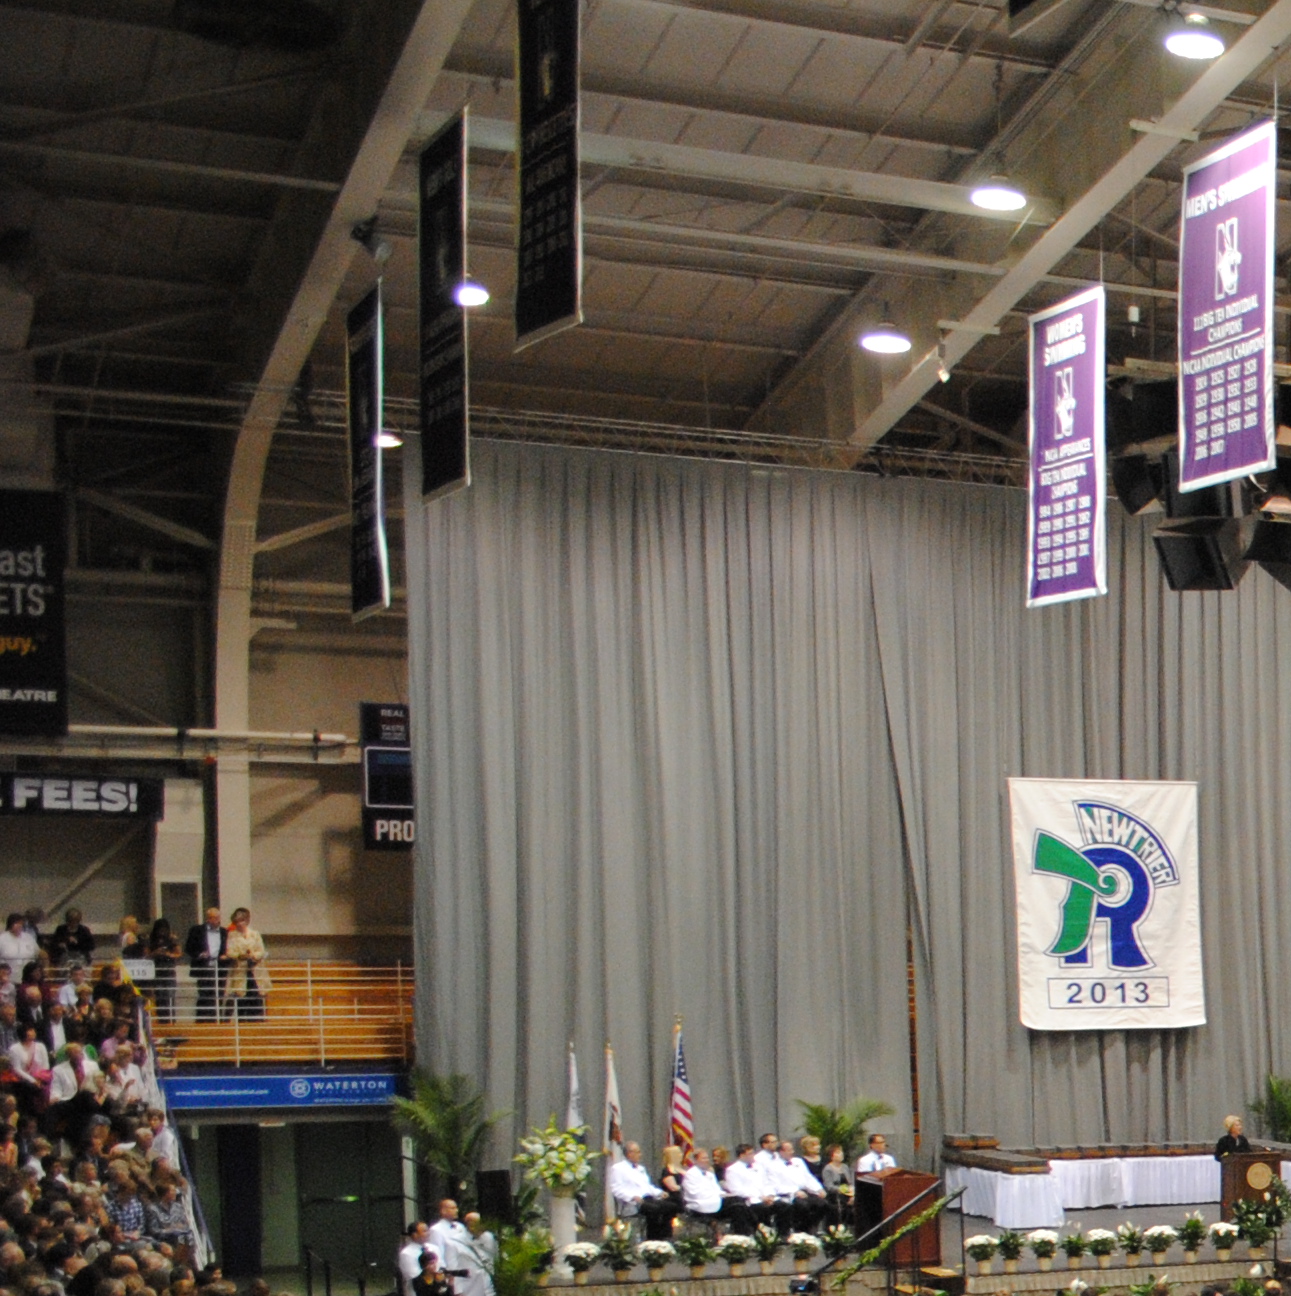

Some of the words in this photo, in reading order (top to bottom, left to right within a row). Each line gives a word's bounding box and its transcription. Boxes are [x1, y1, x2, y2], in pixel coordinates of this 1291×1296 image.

[381, 709, 405, 717] REAL
[13, 778, 138, 812] FEES!
[376, 820, 414, 841] PRO
[1066, 982, 1150, 1004] 2013
[313, 1080, 387, 1090] WATERTON
